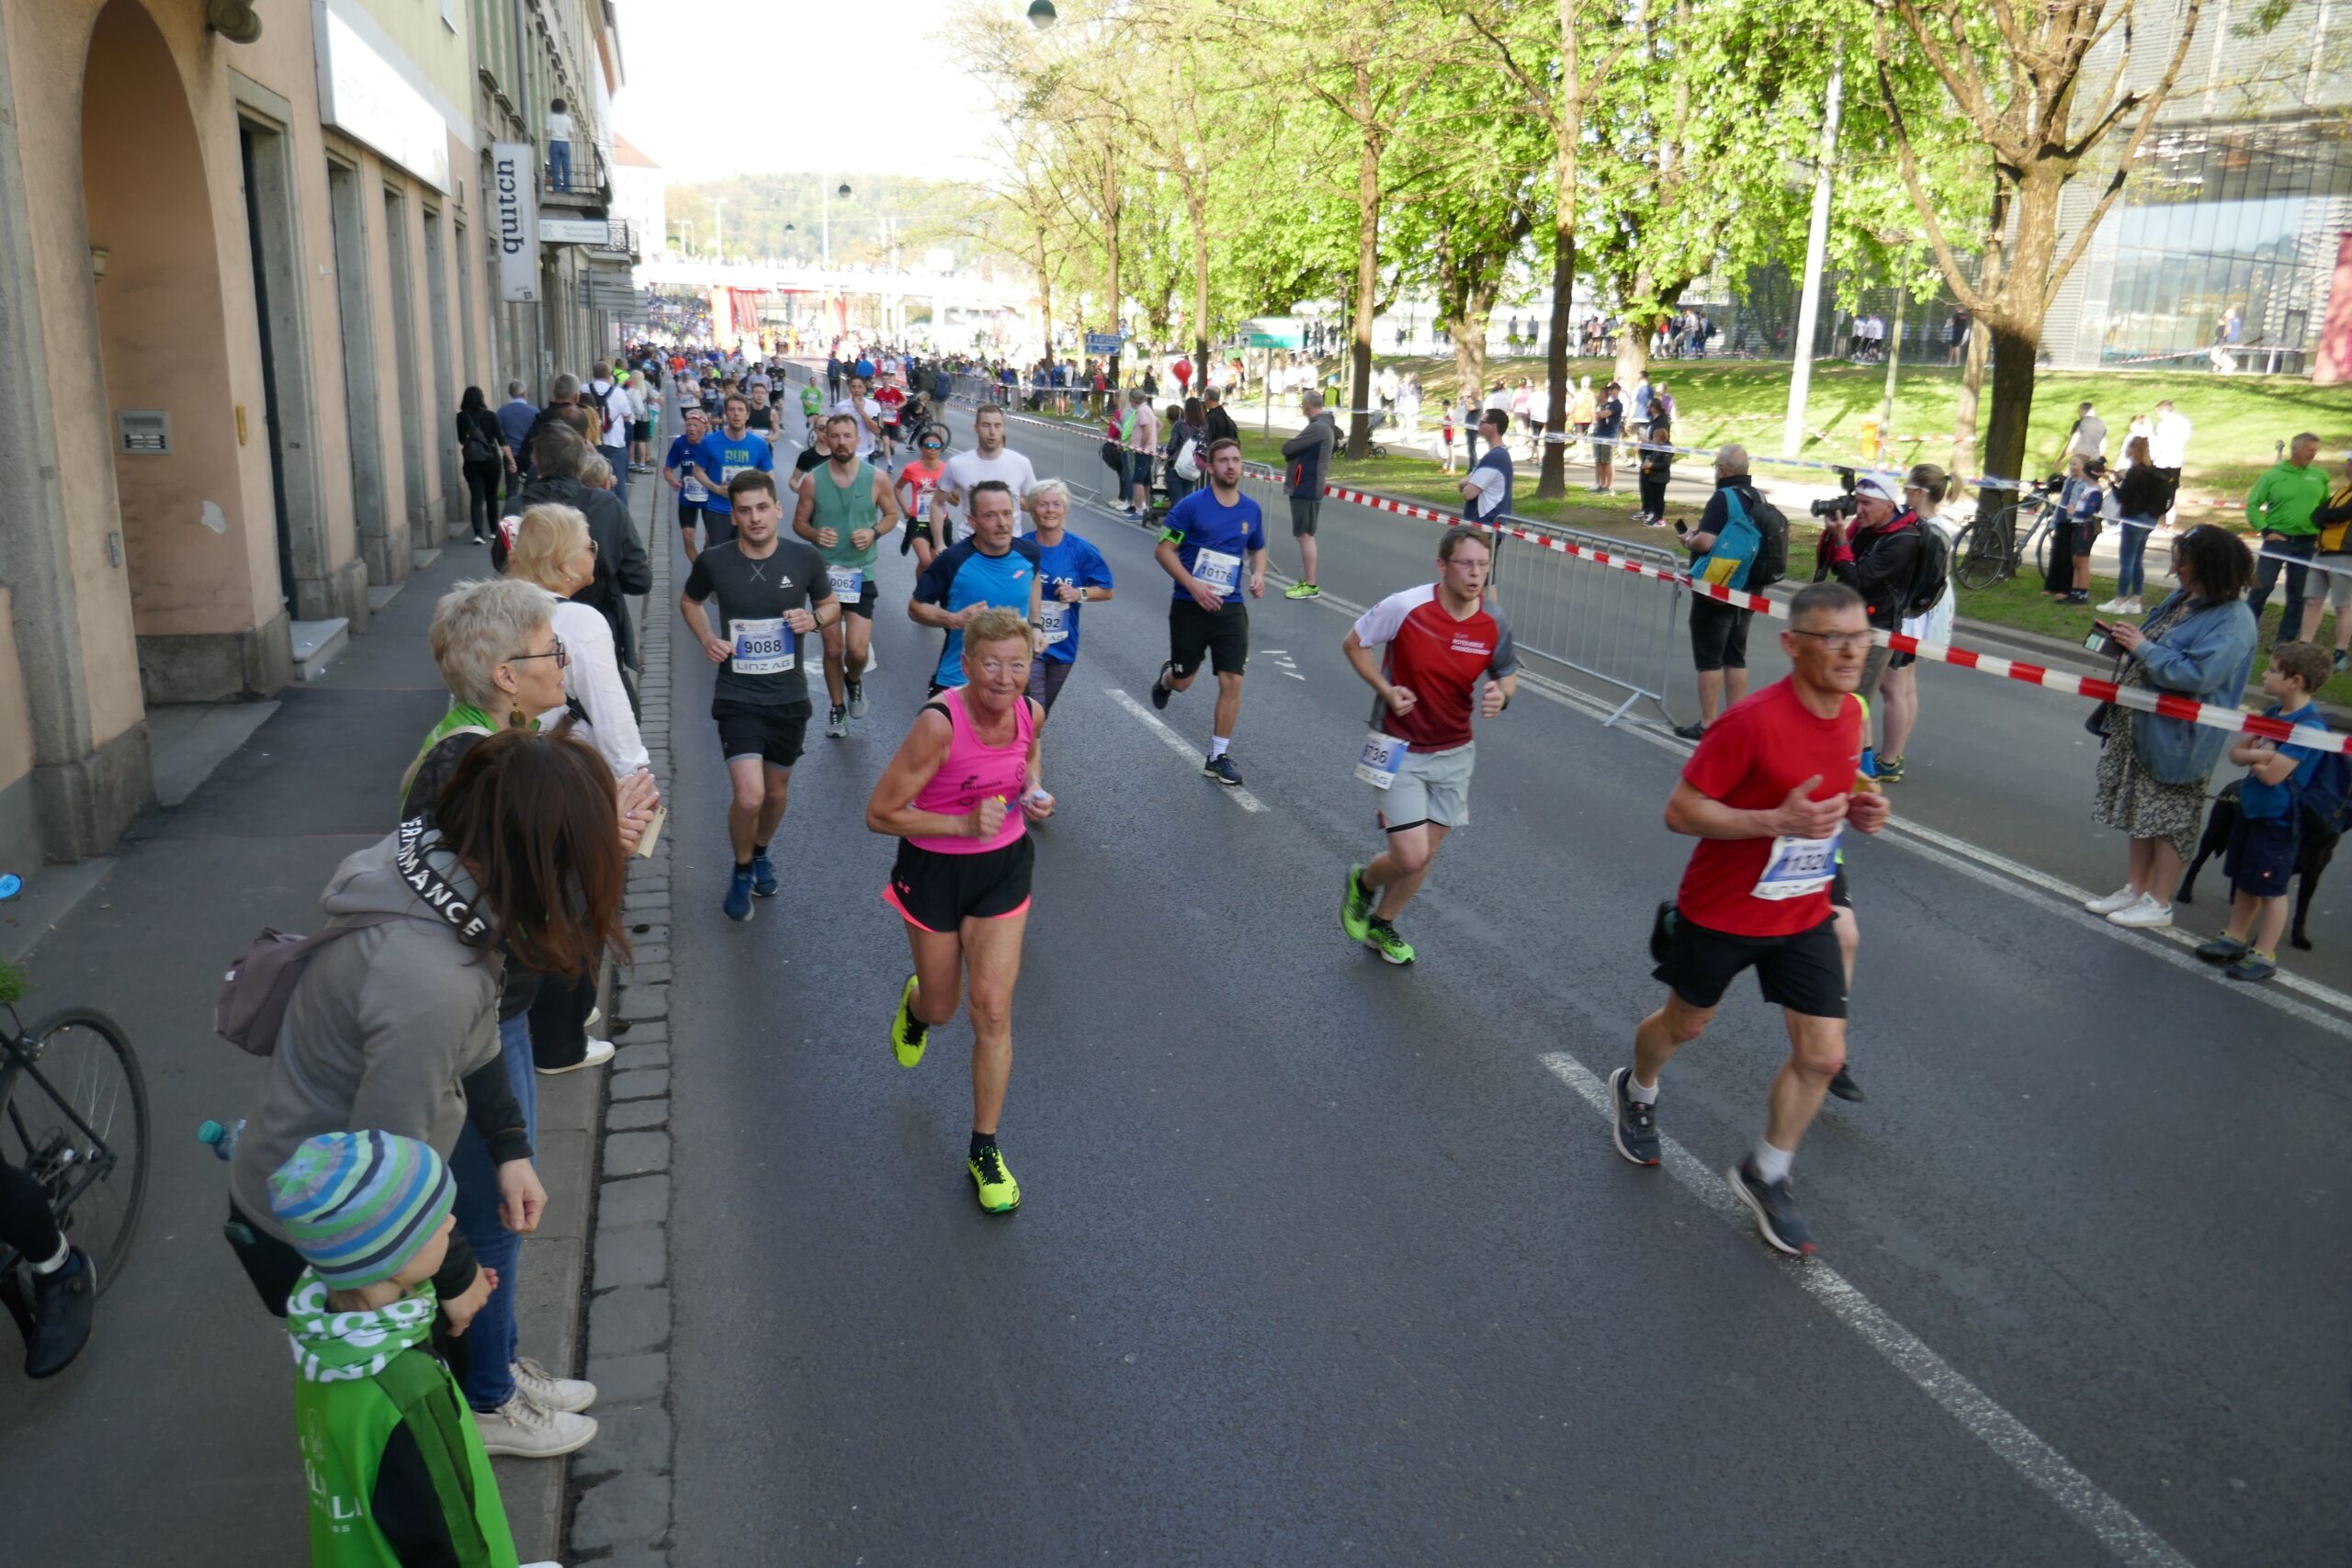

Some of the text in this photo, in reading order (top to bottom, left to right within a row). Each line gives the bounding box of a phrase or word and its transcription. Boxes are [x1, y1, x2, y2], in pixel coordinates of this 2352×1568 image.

[496, 159, 525, 254] quitch
[1201, 566, 1233, 582] 10176
[744, 639, 782, 654] 9088
[772, 659, 791, 671] AG
